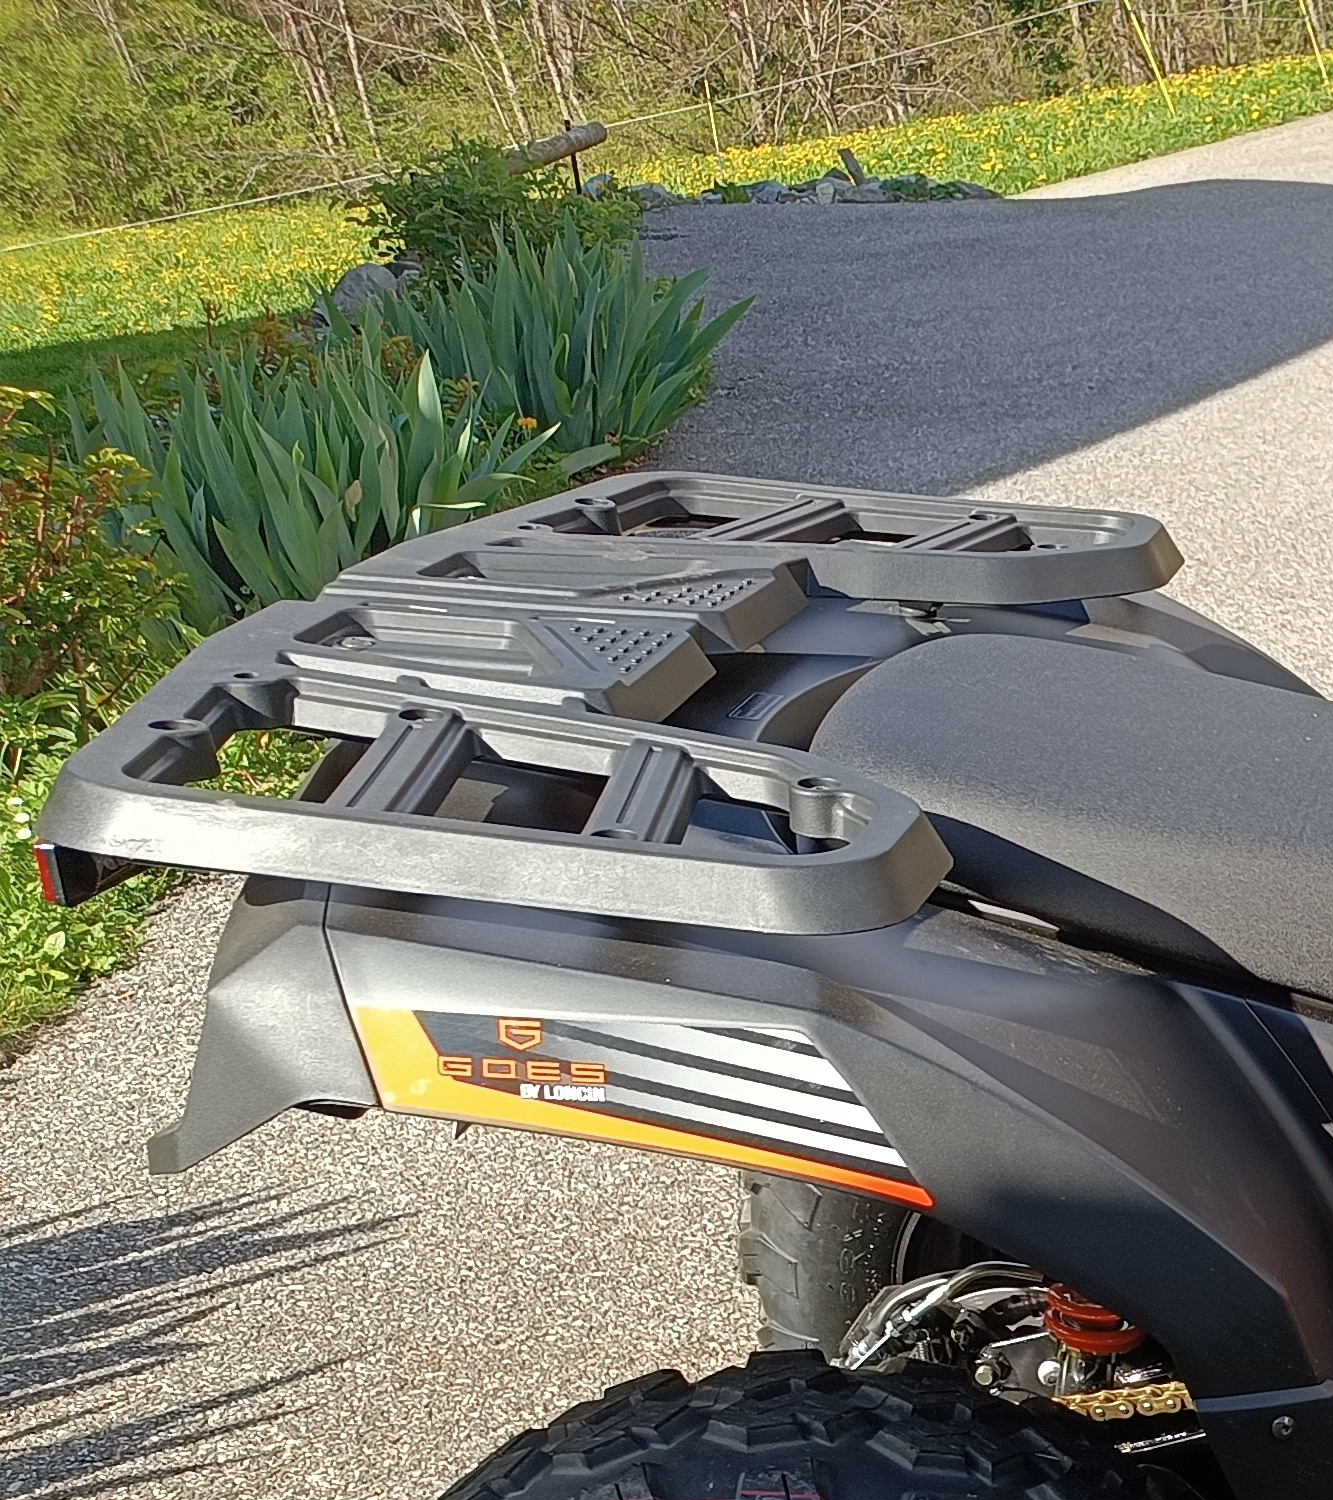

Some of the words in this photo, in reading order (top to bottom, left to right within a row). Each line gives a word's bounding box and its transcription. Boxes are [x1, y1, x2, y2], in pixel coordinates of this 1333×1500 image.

[437, 1055, 607, 1084] GOES
[519, 1083, 541, 1100] BY
[544, 1084, 606, 1102] LONCIN
